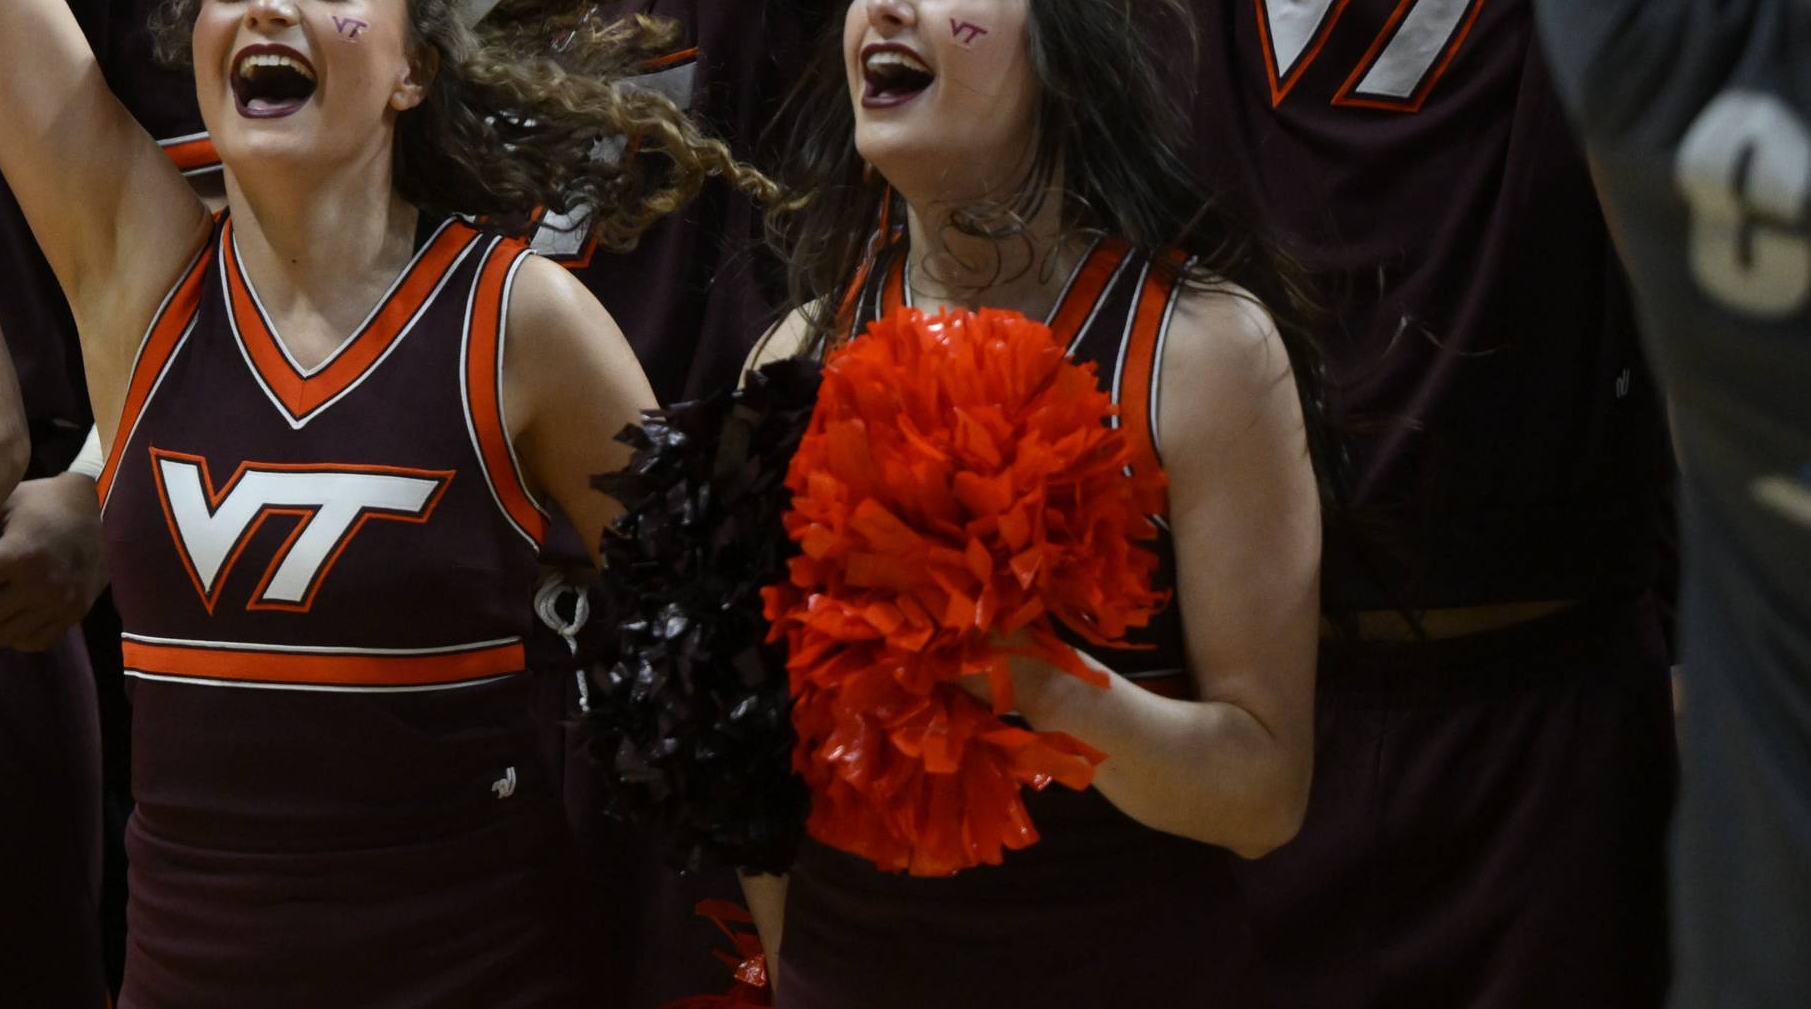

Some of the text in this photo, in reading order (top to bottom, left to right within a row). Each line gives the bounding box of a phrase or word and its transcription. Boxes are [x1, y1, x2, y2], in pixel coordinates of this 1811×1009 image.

[331, 15, 367, 38] VT
[949, 17, 987, 43] VT
[148, 444, 457, 615] VT
